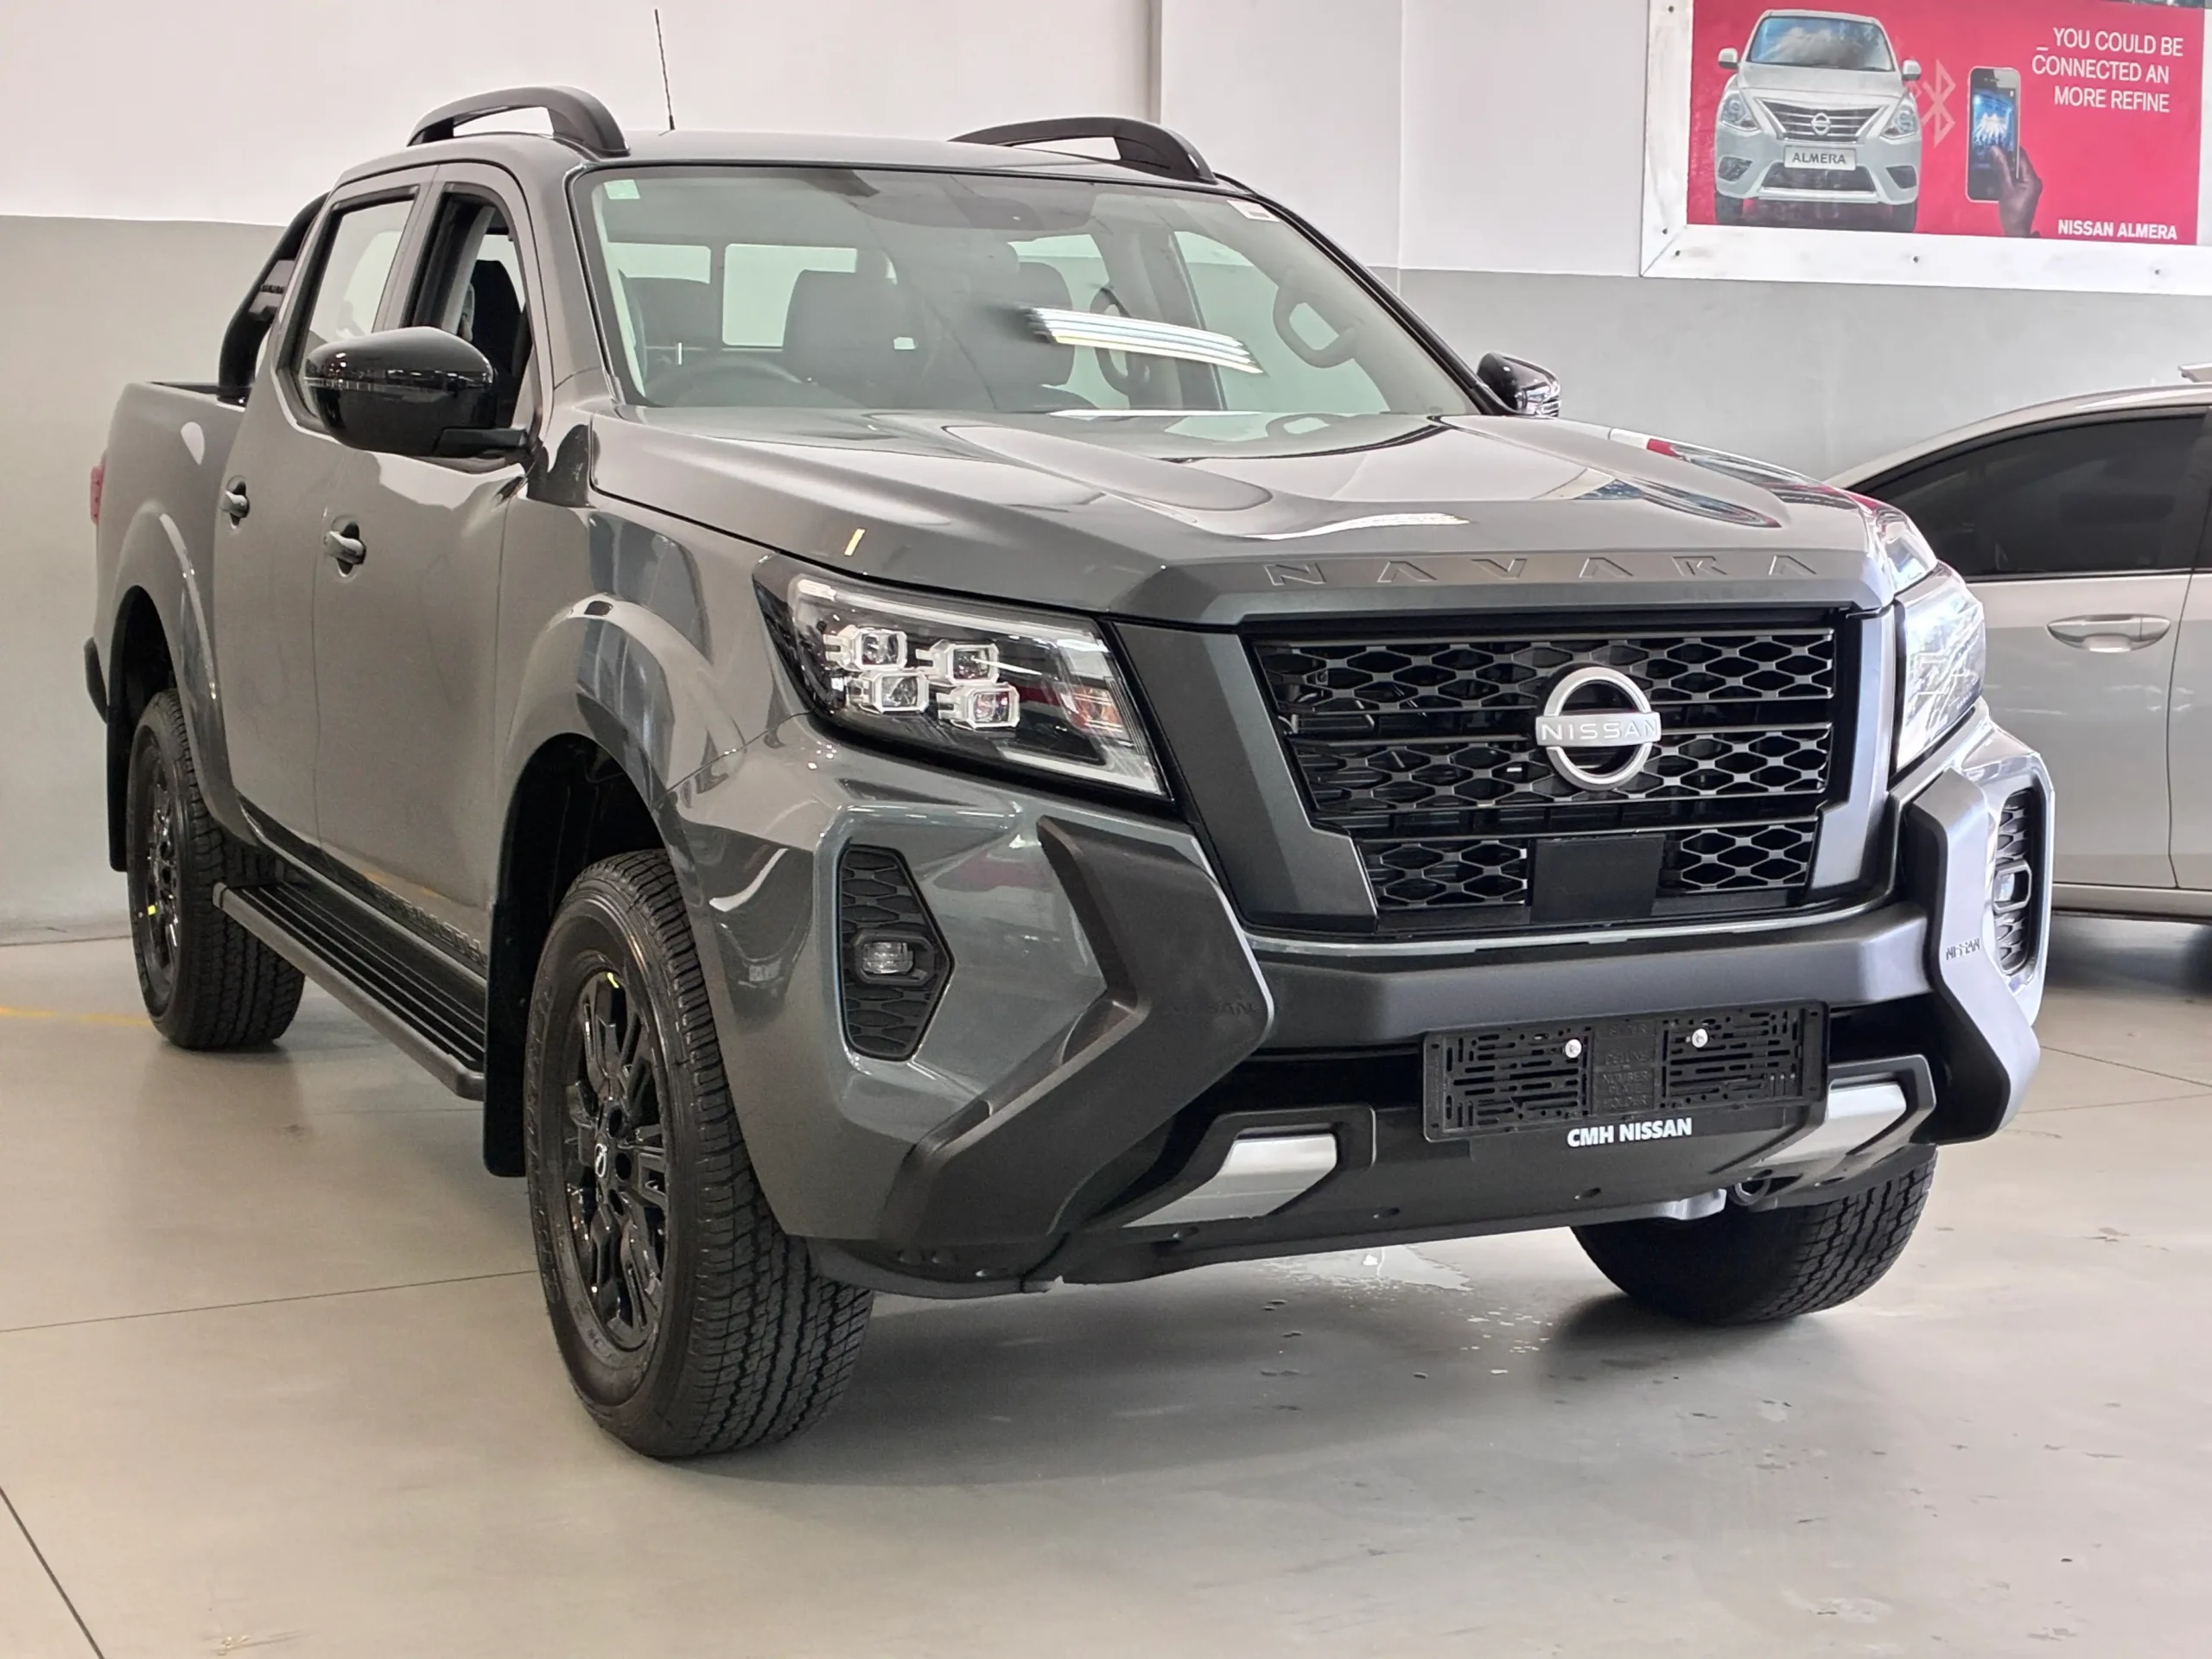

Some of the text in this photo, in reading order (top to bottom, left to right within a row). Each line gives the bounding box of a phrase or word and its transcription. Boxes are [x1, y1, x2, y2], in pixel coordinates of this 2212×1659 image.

[2053, 27, 2183, 57] YOU COULD BE
[2031, 54, 2170, 84] CONNECTED AN
[2054, 85, 2170, 112] MORE REFINE
[1792, 152, 1847, 164] ALMERA
[2057, 219, 2177, 240] NISSAN ALMERA
[1264, 555, 1818, 586] NAVARA
[1541, 719, 1657, 741] NISSAN
[1567, 1117, 1693, 1147] CMH NISSAN
